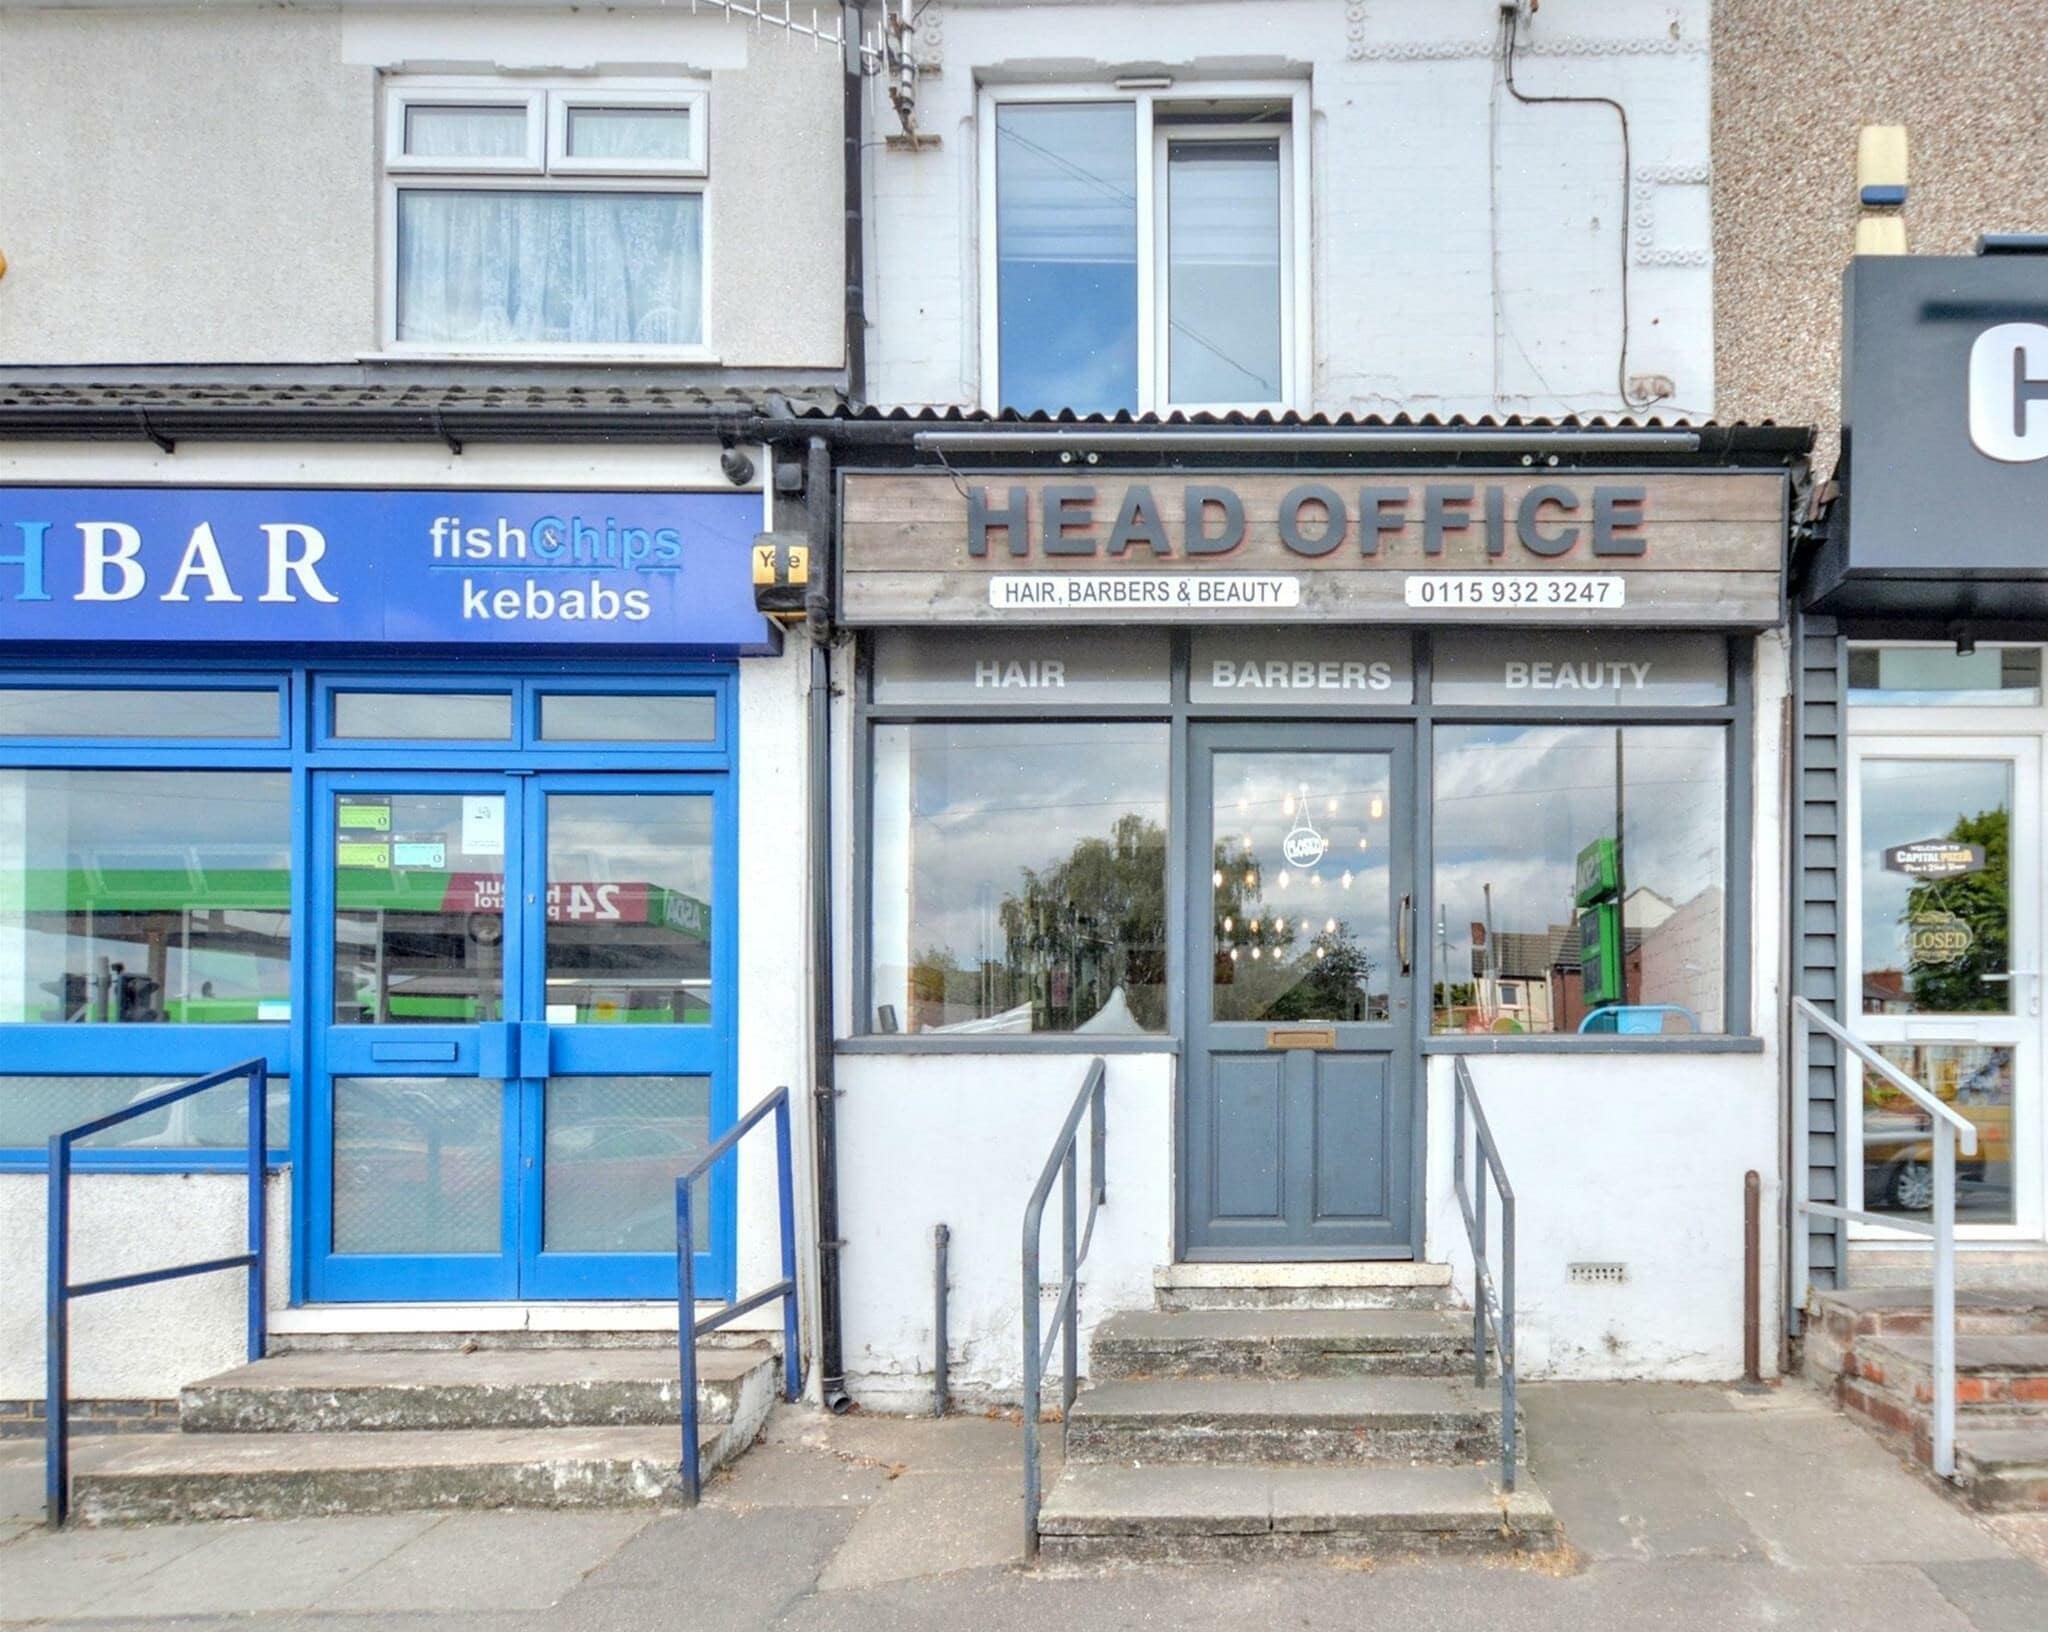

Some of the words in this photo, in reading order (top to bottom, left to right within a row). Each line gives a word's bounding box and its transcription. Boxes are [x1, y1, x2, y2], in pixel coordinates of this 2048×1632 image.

[967, 485, 1245, 557] HEAD
[1278, 484, 1647, 557] OFFICE
[72, 520, 341, 603] BAR
[429, 517, 527, 559] fish
[530, 516, 682, 570] Chips
[463, 579, 651, 621] kebabs
[1004, 582, 1063, 605] HAIR,
[1067, 582, 1171, 603] BARBERS
[1176, 582, 1191, 602] &
[1197, 582, 1284, 603] BEAUTY
[1421, 582, 1483, 603] 0115
[1492, 582, 1539, 603] 932
[1547, 582, 1611, 603] 3247
[974, 660, 1065, 689] HAIR
[1212, 660, 1392, 690] BARBERS
[1504, 661, 1652, 690] BEAUTY
